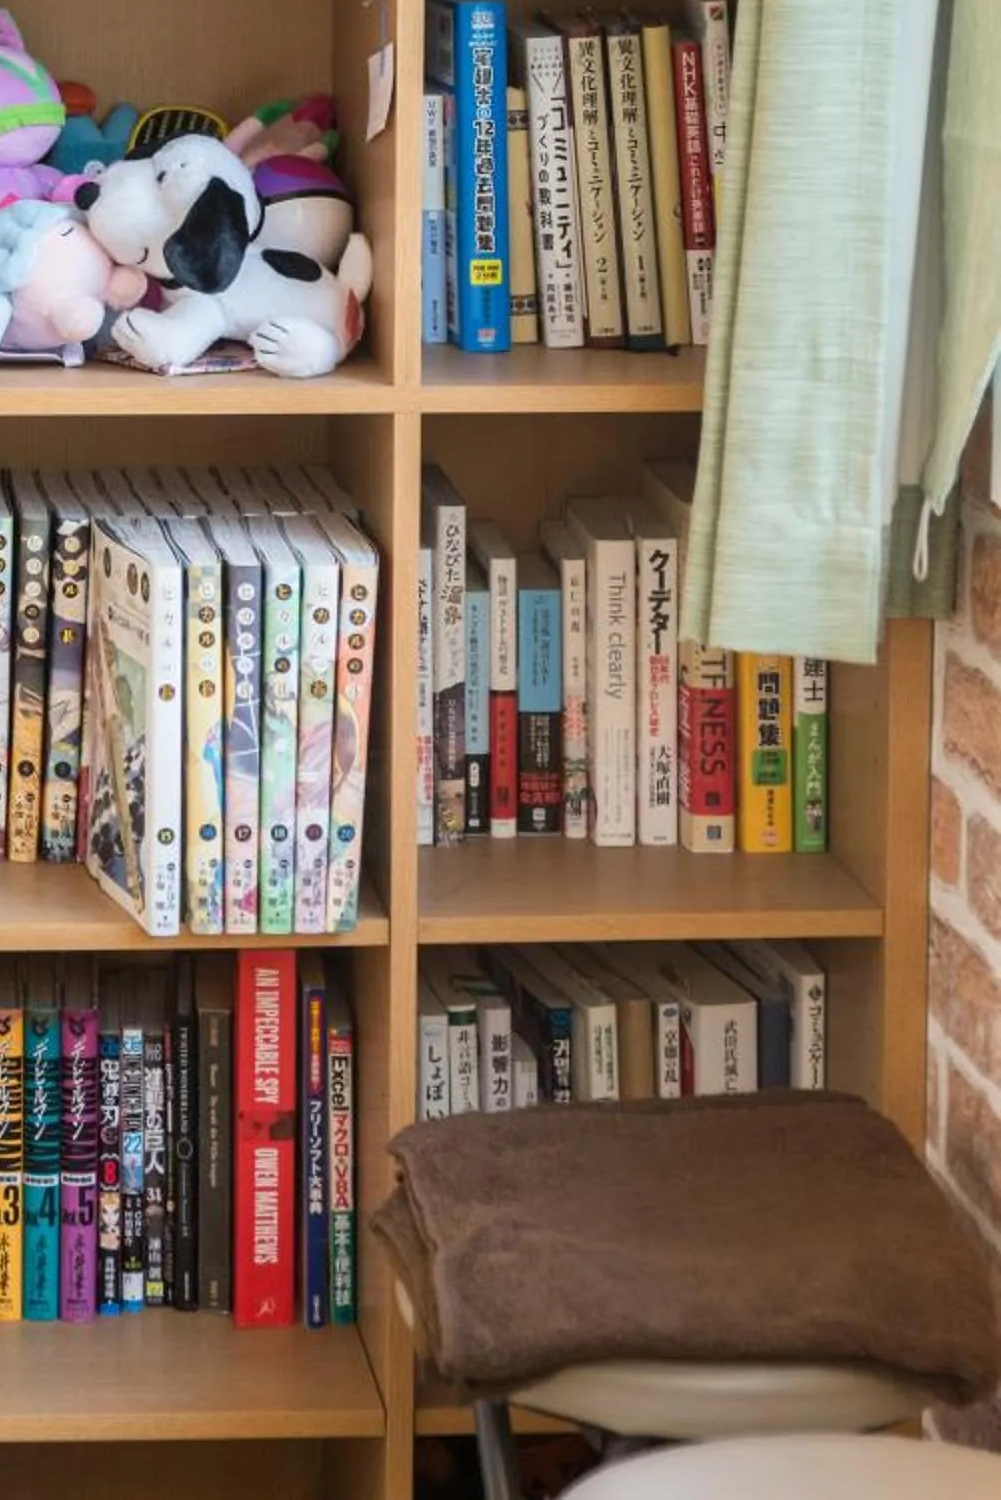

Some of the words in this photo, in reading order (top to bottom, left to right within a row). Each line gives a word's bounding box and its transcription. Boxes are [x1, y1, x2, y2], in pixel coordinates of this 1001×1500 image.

[549, 97, 574, 269] 「コミュニティ」
[577, 40, 605, 244] 異文化理解とコミュニケーション
[596, 258, 608, 273] 2
[616, 38, 647, 242] 異文化理解とコミュニケーション
[636, 254, 644, 272] 1
[608, 571, 626, 625] Think
[649, 550, 672, 655] クーデター
[604, 631, 629, 700] clearly
[758, 671, 781, 747] 問題集
[254, 967, 280, 986] AN
[254, 990, 280, 1077] IMPECCABLE
[491, 1032, 509, 1108] 影響力の
[33, 1034, 49, 1141] デビルマン
[71, 1035, 87, 1141] デビルマン
[100, 1059, 120, 1127] 鬼滅の刃
[145, 1067, 165, 1175] 進撃の巨人
[254, 1080, 280, 1105] SPY
[331, 1055, 349, 1111] Excel
[106, 1160, 116, 1185] 8
[124, 1135, 142, 1152] 22
[253, 1147, 279, 1184] OWEN
[147, 1187, 162, 1202] 31
[253, 1188, 279, 1265] MATTHEWS
